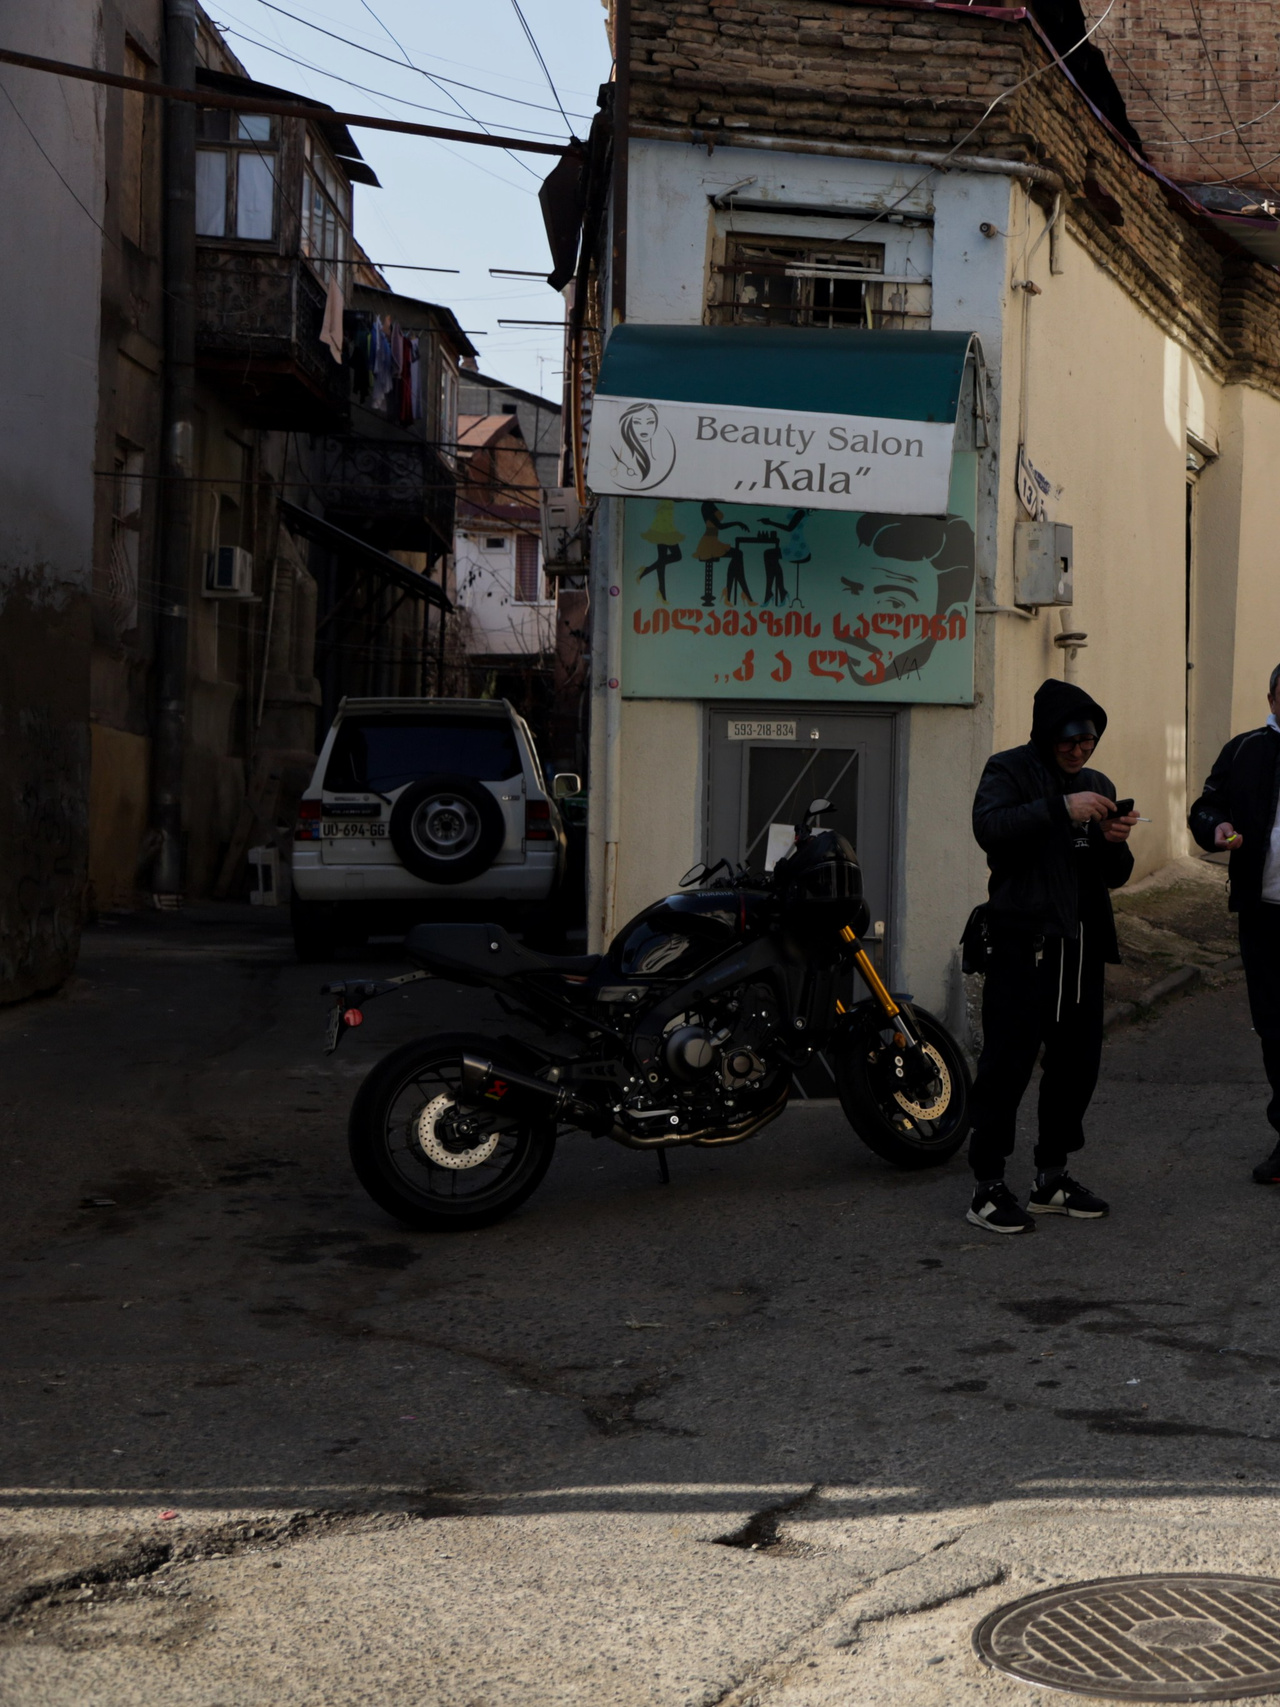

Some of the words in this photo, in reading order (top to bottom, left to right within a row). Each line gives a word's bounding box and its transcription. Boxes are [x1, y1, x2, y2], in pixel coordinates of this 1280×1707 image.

[696, 415, 815, 455] Beauty
[827, 426, 924, 457] Salon
[633, 608, 821, 638] სილამაზის
[832, 612, 967, 641] სალონი
[734, 723, 794, 736] 593-218-834
